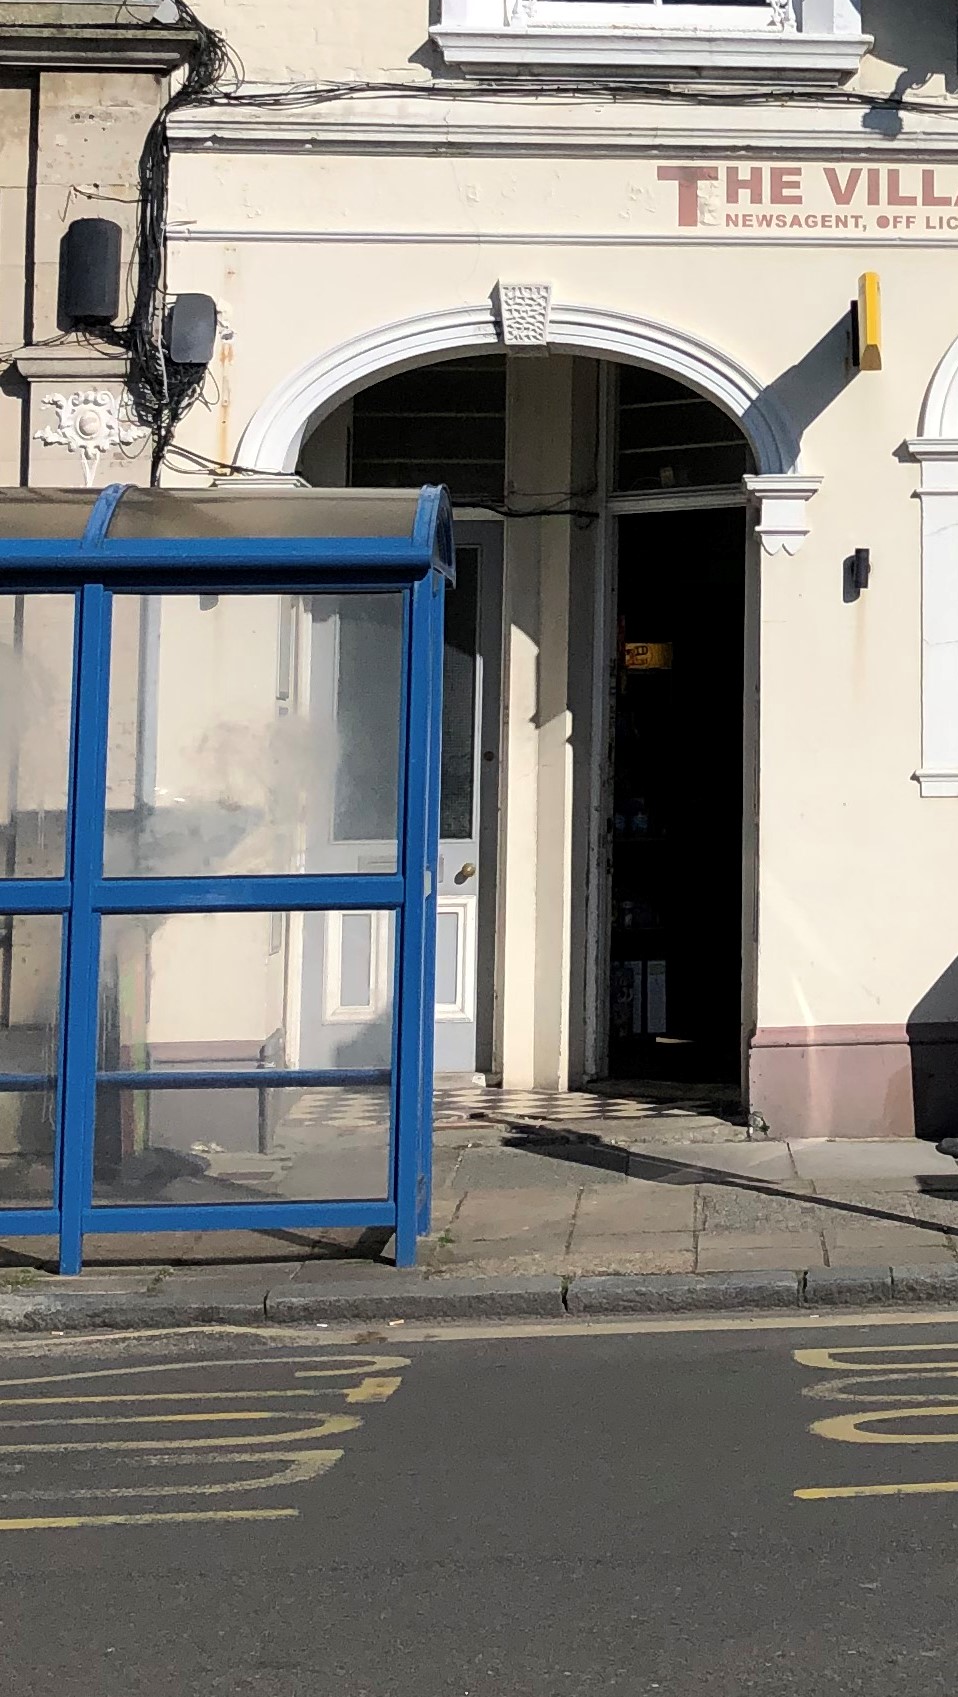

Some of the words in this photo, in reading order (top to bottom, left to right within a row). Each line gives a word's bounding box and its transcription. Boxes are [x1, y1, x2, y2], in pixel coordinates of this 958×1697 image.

[657, 165, 804, 227] THE
[725, 213, 868, 232] NEWSAGENT,
[876, 214, 917, 230] OFF
